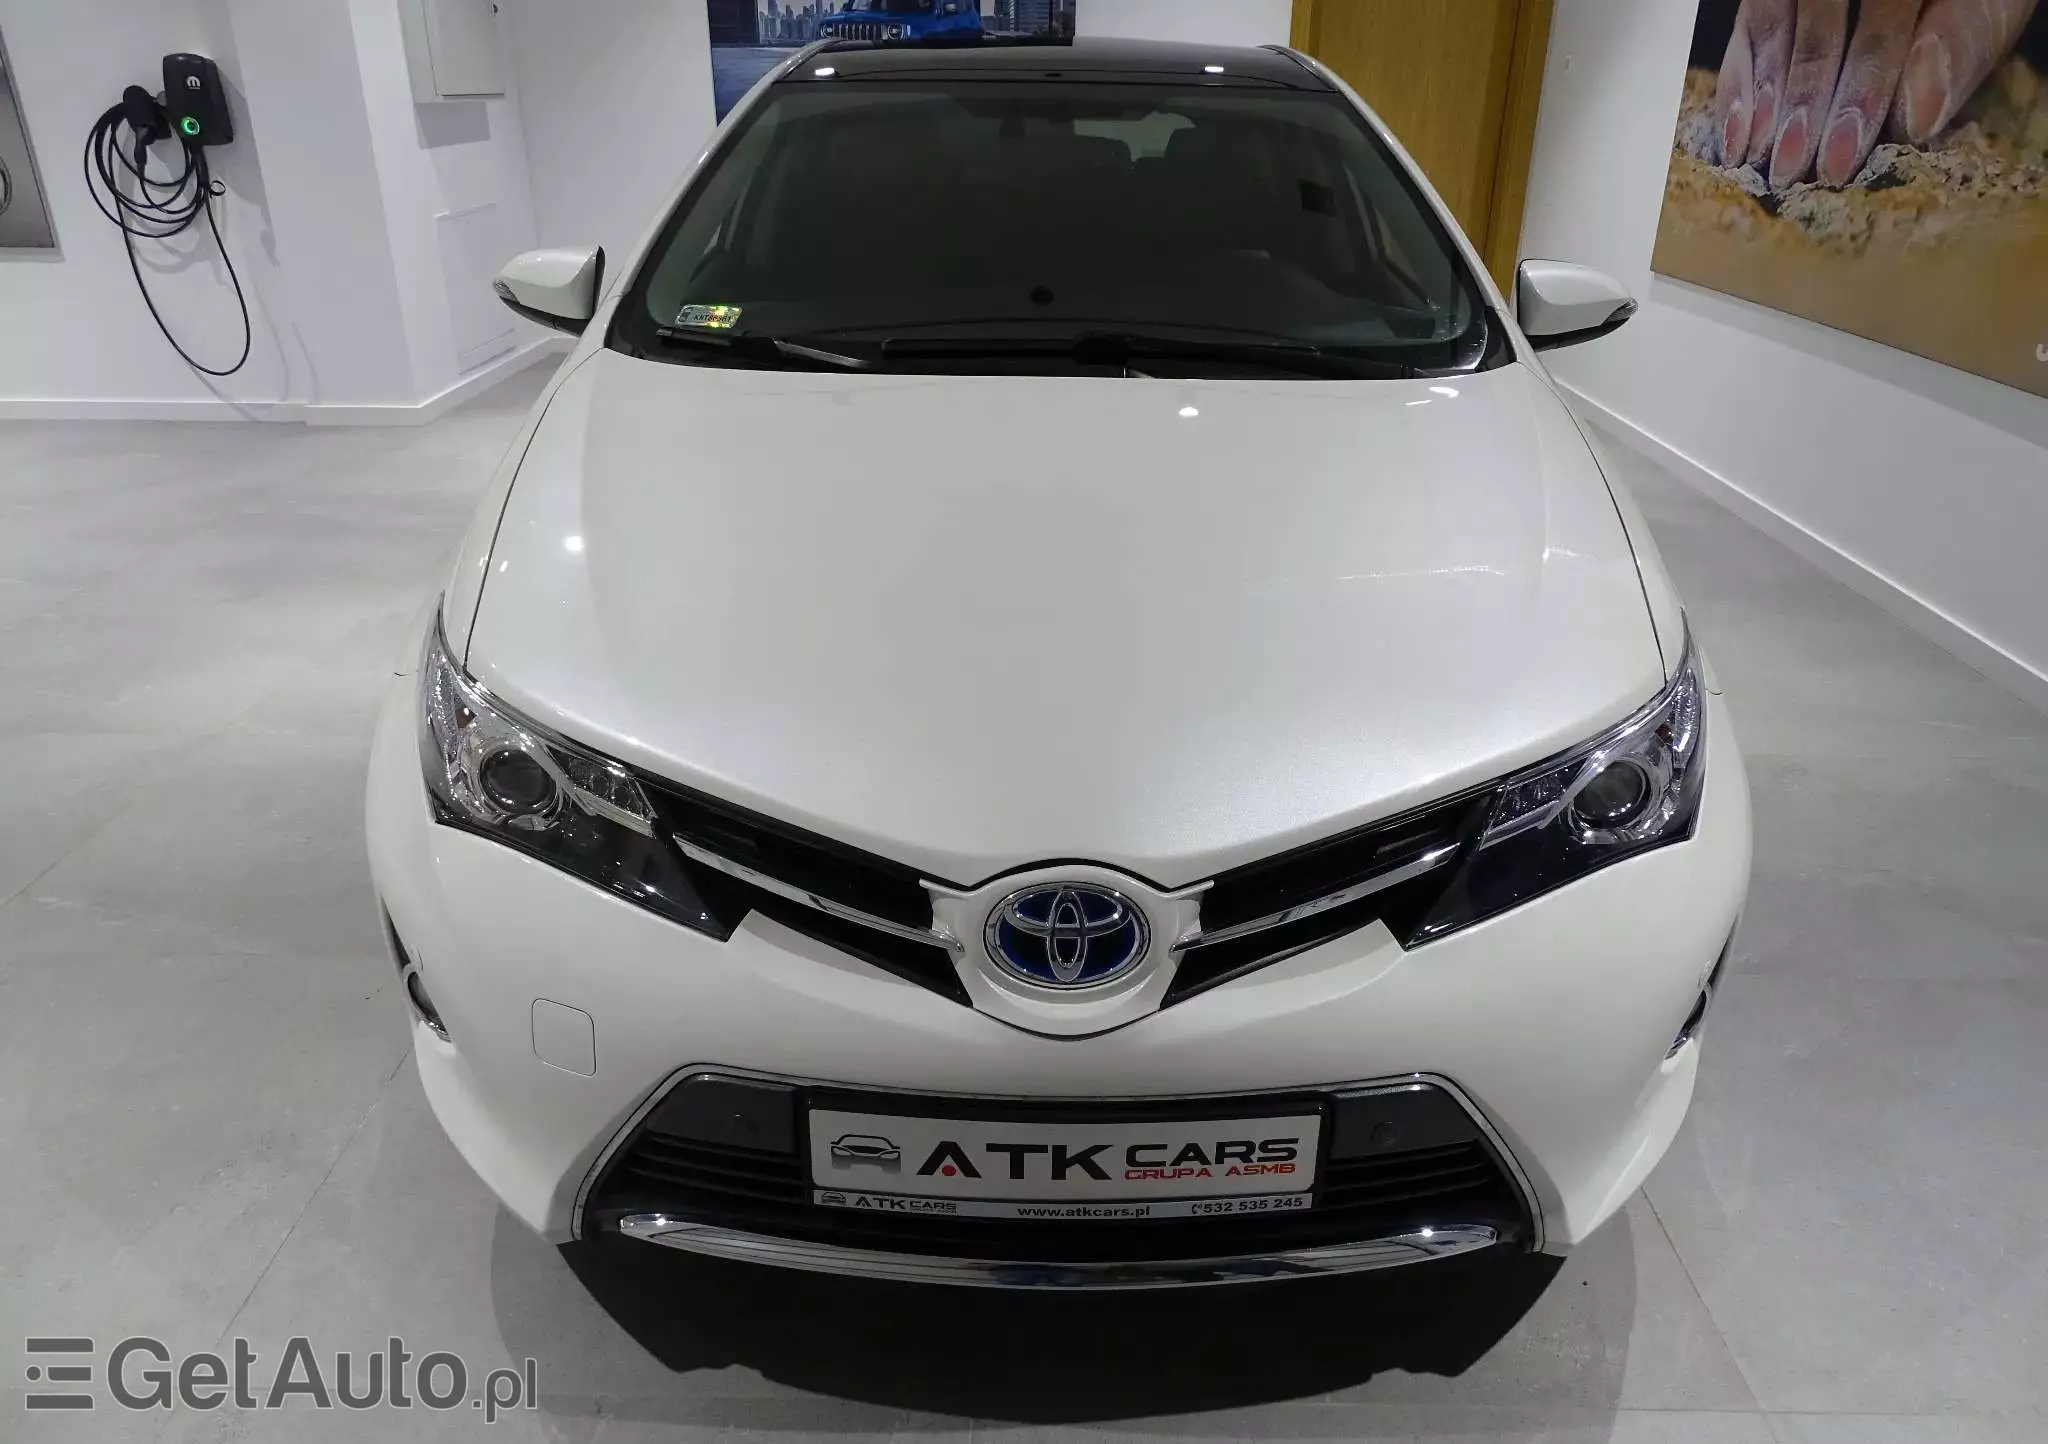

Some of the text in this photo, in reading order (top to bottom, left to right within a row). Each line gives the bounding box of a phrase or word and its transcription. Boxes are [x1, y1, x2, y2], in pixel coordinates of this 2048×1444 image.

[915, 1140, 1114, 1181] ATK
[1125, 1138, 1299, 1167] CARS
[1124, 1163, 1296, 1181] GRUPA ASMB
[855, 1196, 906, 1209] ATK
[909, 1200, 957, 1210] CARS
[1017, 1205, 1151, 1218] www.atkcars.pl
[1203, 1196, 1304, 1214] 532 535 245
